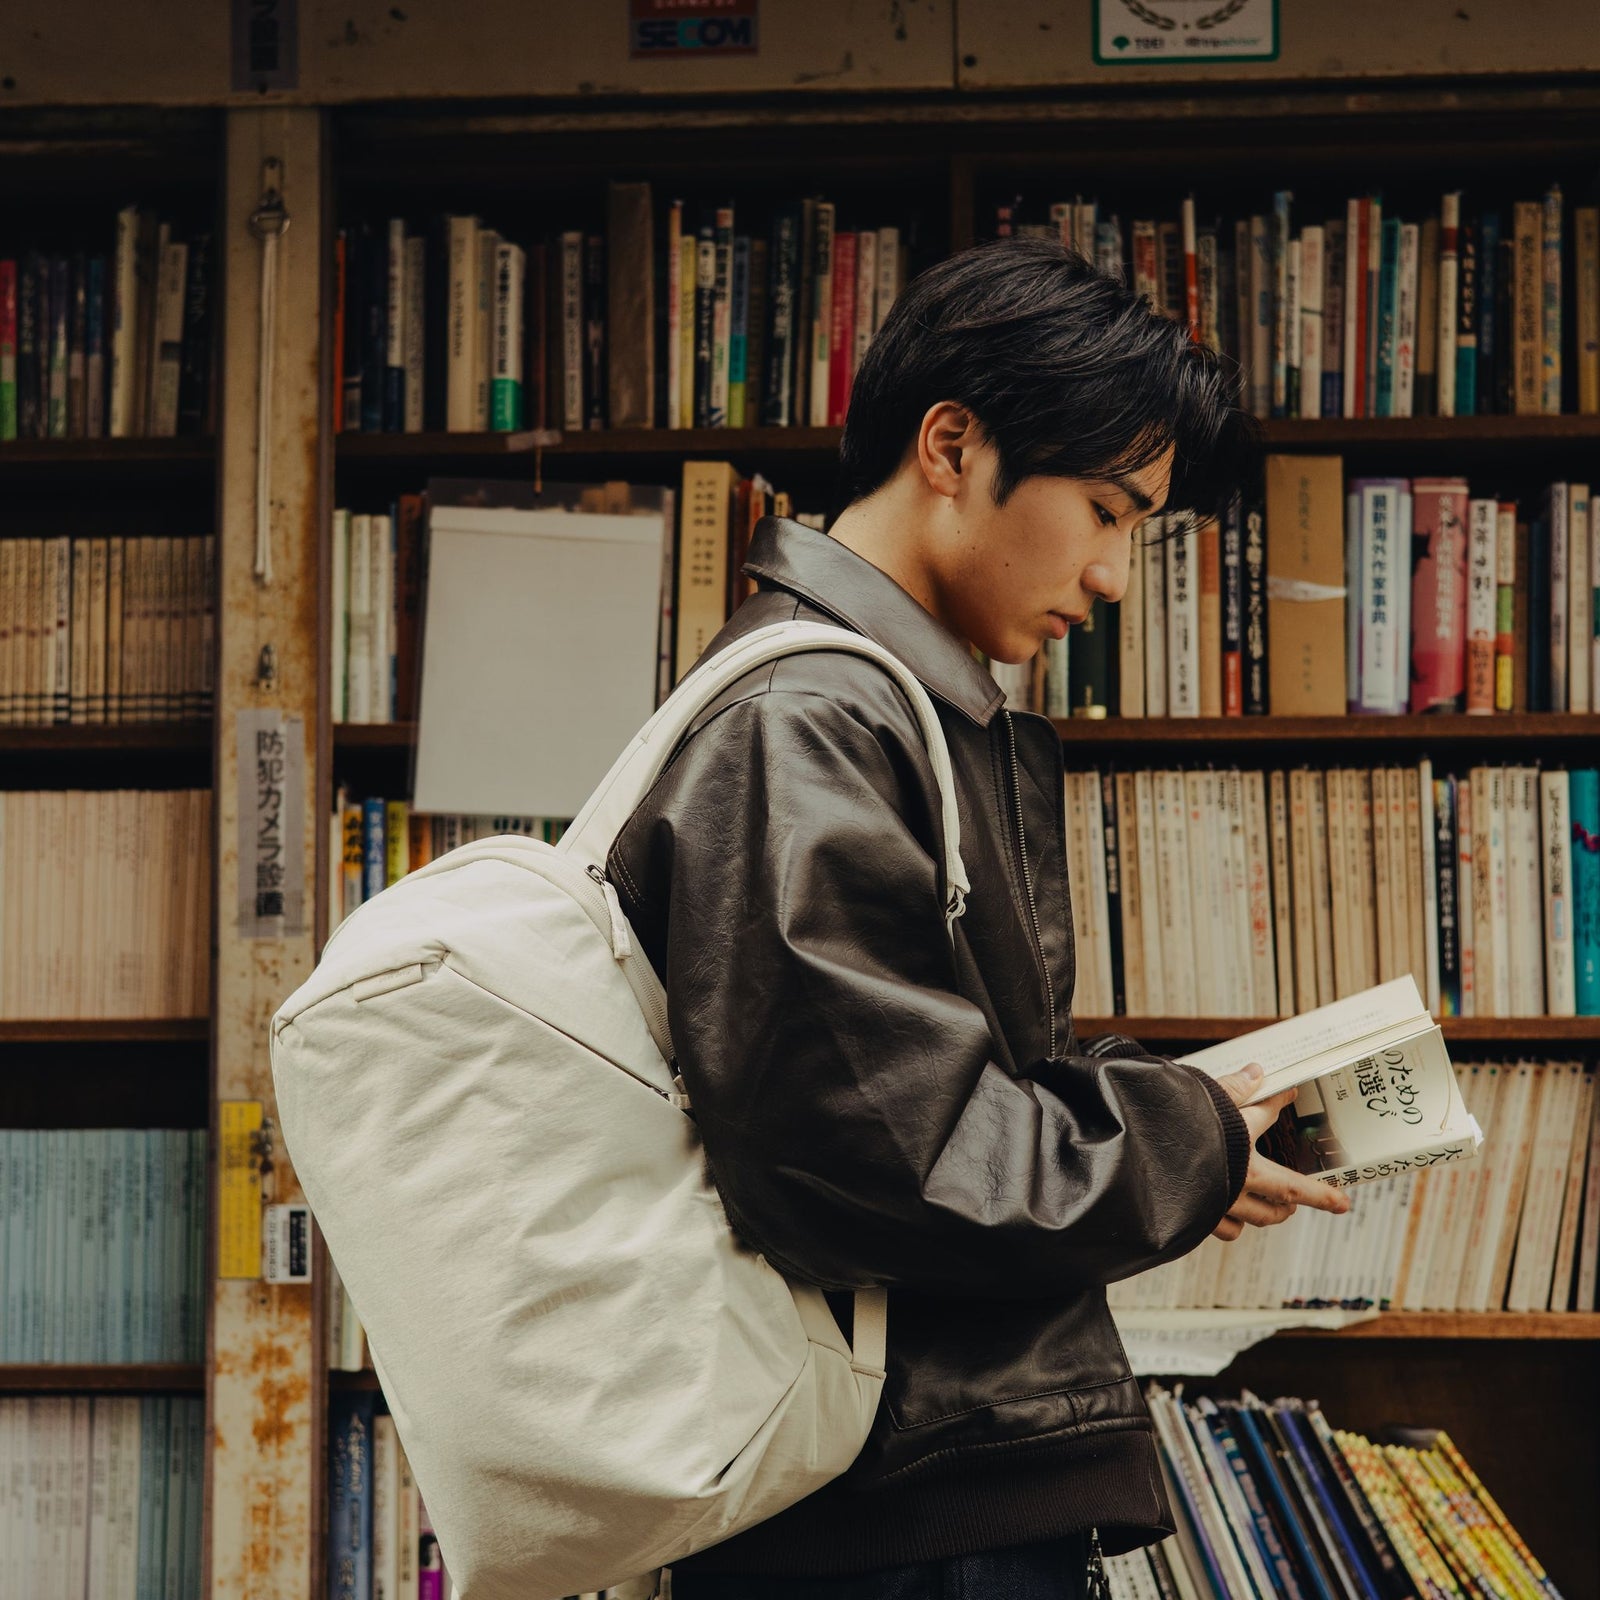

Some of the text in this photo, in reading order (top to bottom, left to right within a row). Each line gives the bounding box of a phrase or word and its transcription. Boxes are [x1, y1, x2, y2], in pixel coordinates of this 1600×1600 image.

[639, 17, 751, 48] SECOM
[1317, 1144, 1463, 1188] 大人のための映画
